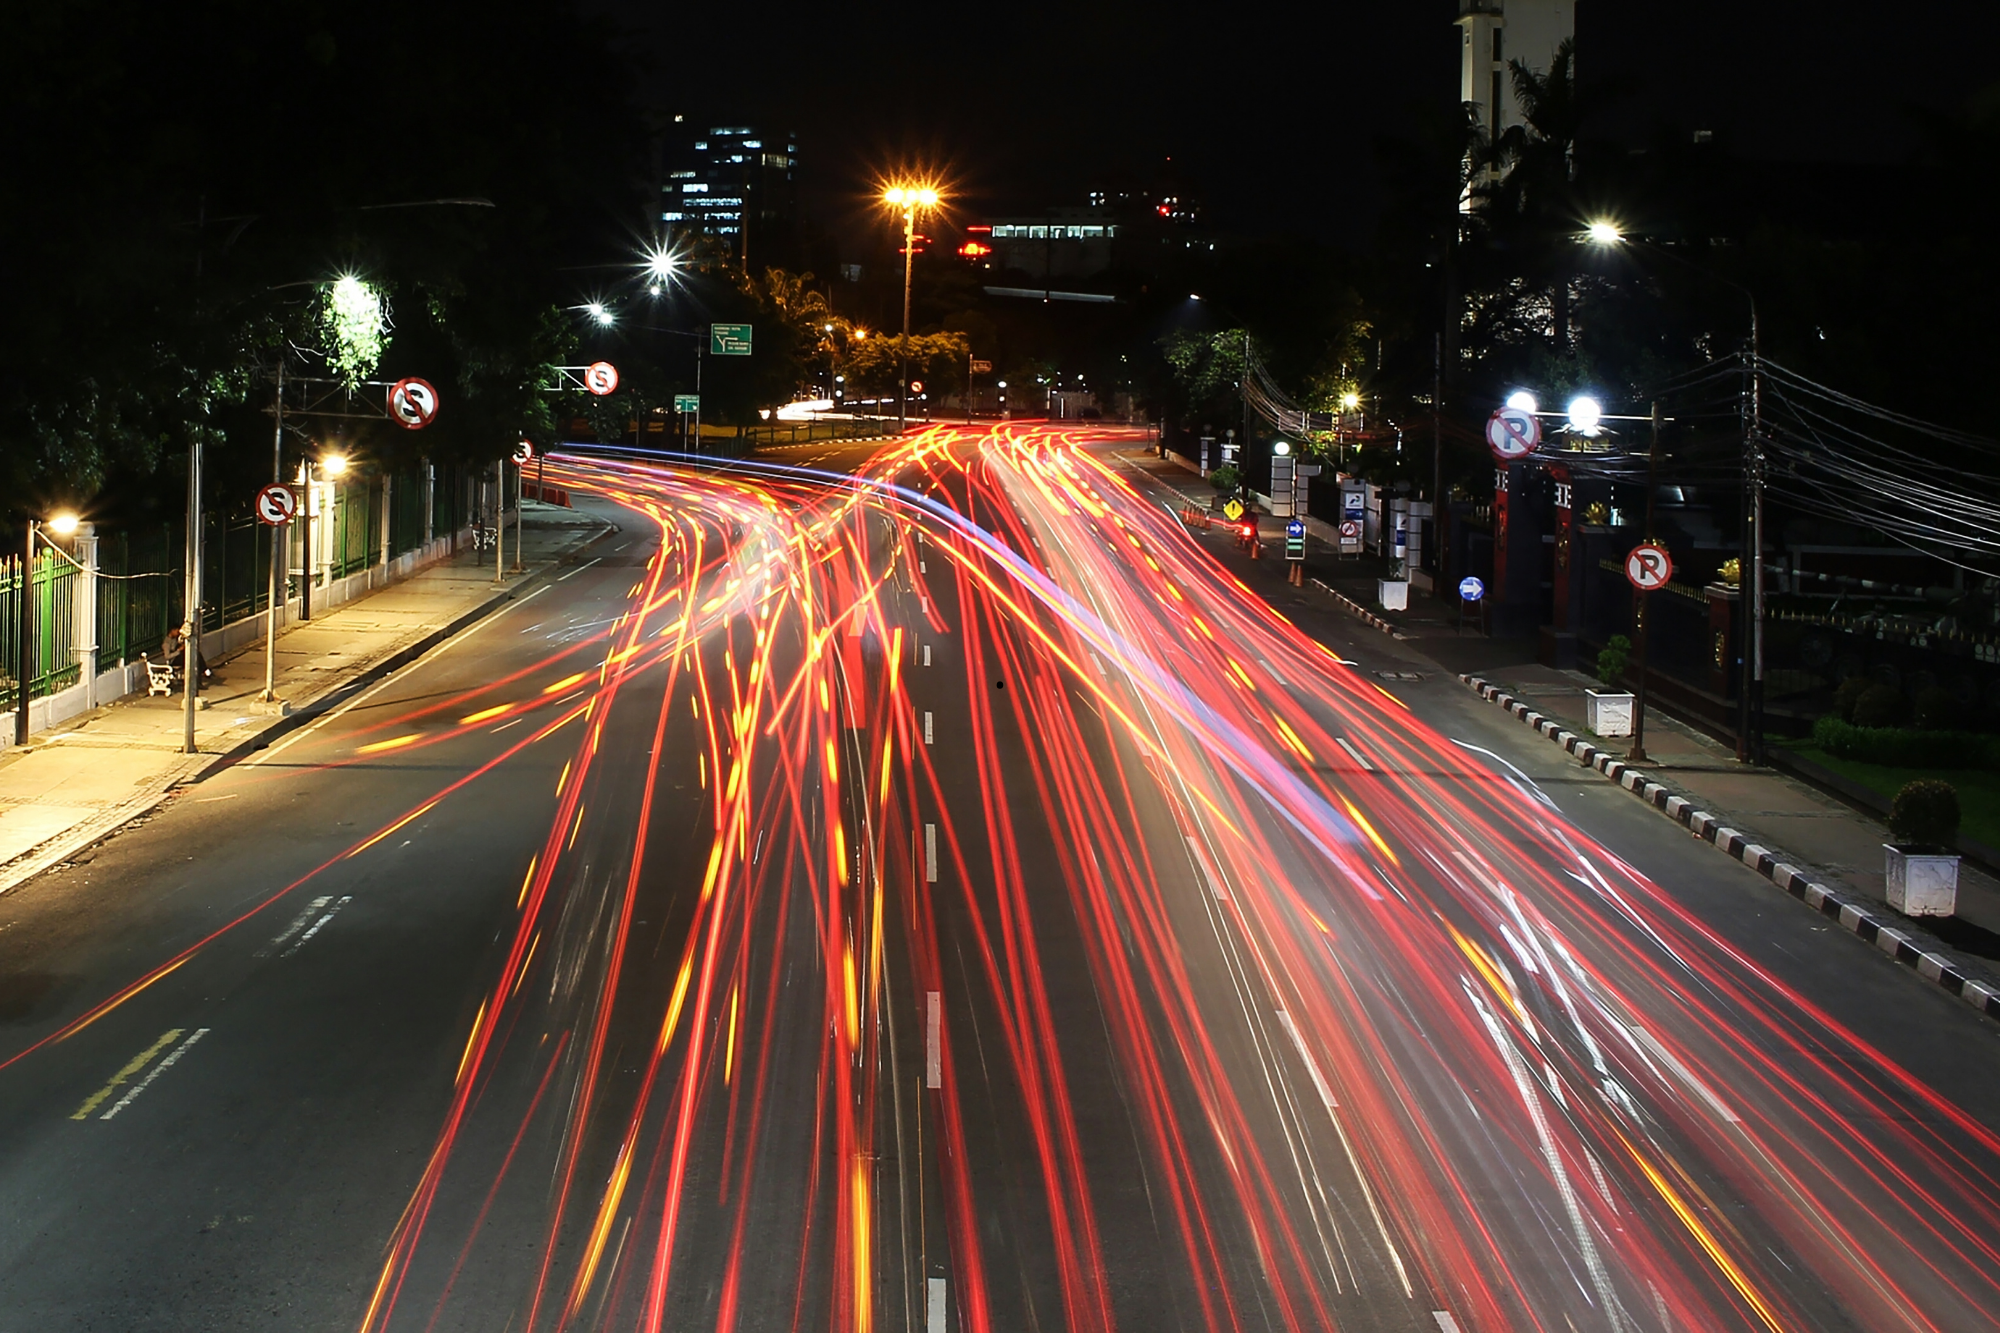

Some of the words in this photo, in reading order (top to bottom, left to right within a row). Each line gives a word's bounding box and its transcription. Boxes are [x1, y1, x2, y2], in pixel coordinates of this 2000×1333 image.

[596, 370, 608, 387] S
[404, 390, 423, 416] S
[1505, 419, 1527, 449] P
[269, 493, 285, 515] S
[1641, 556, 1660, 579] P
